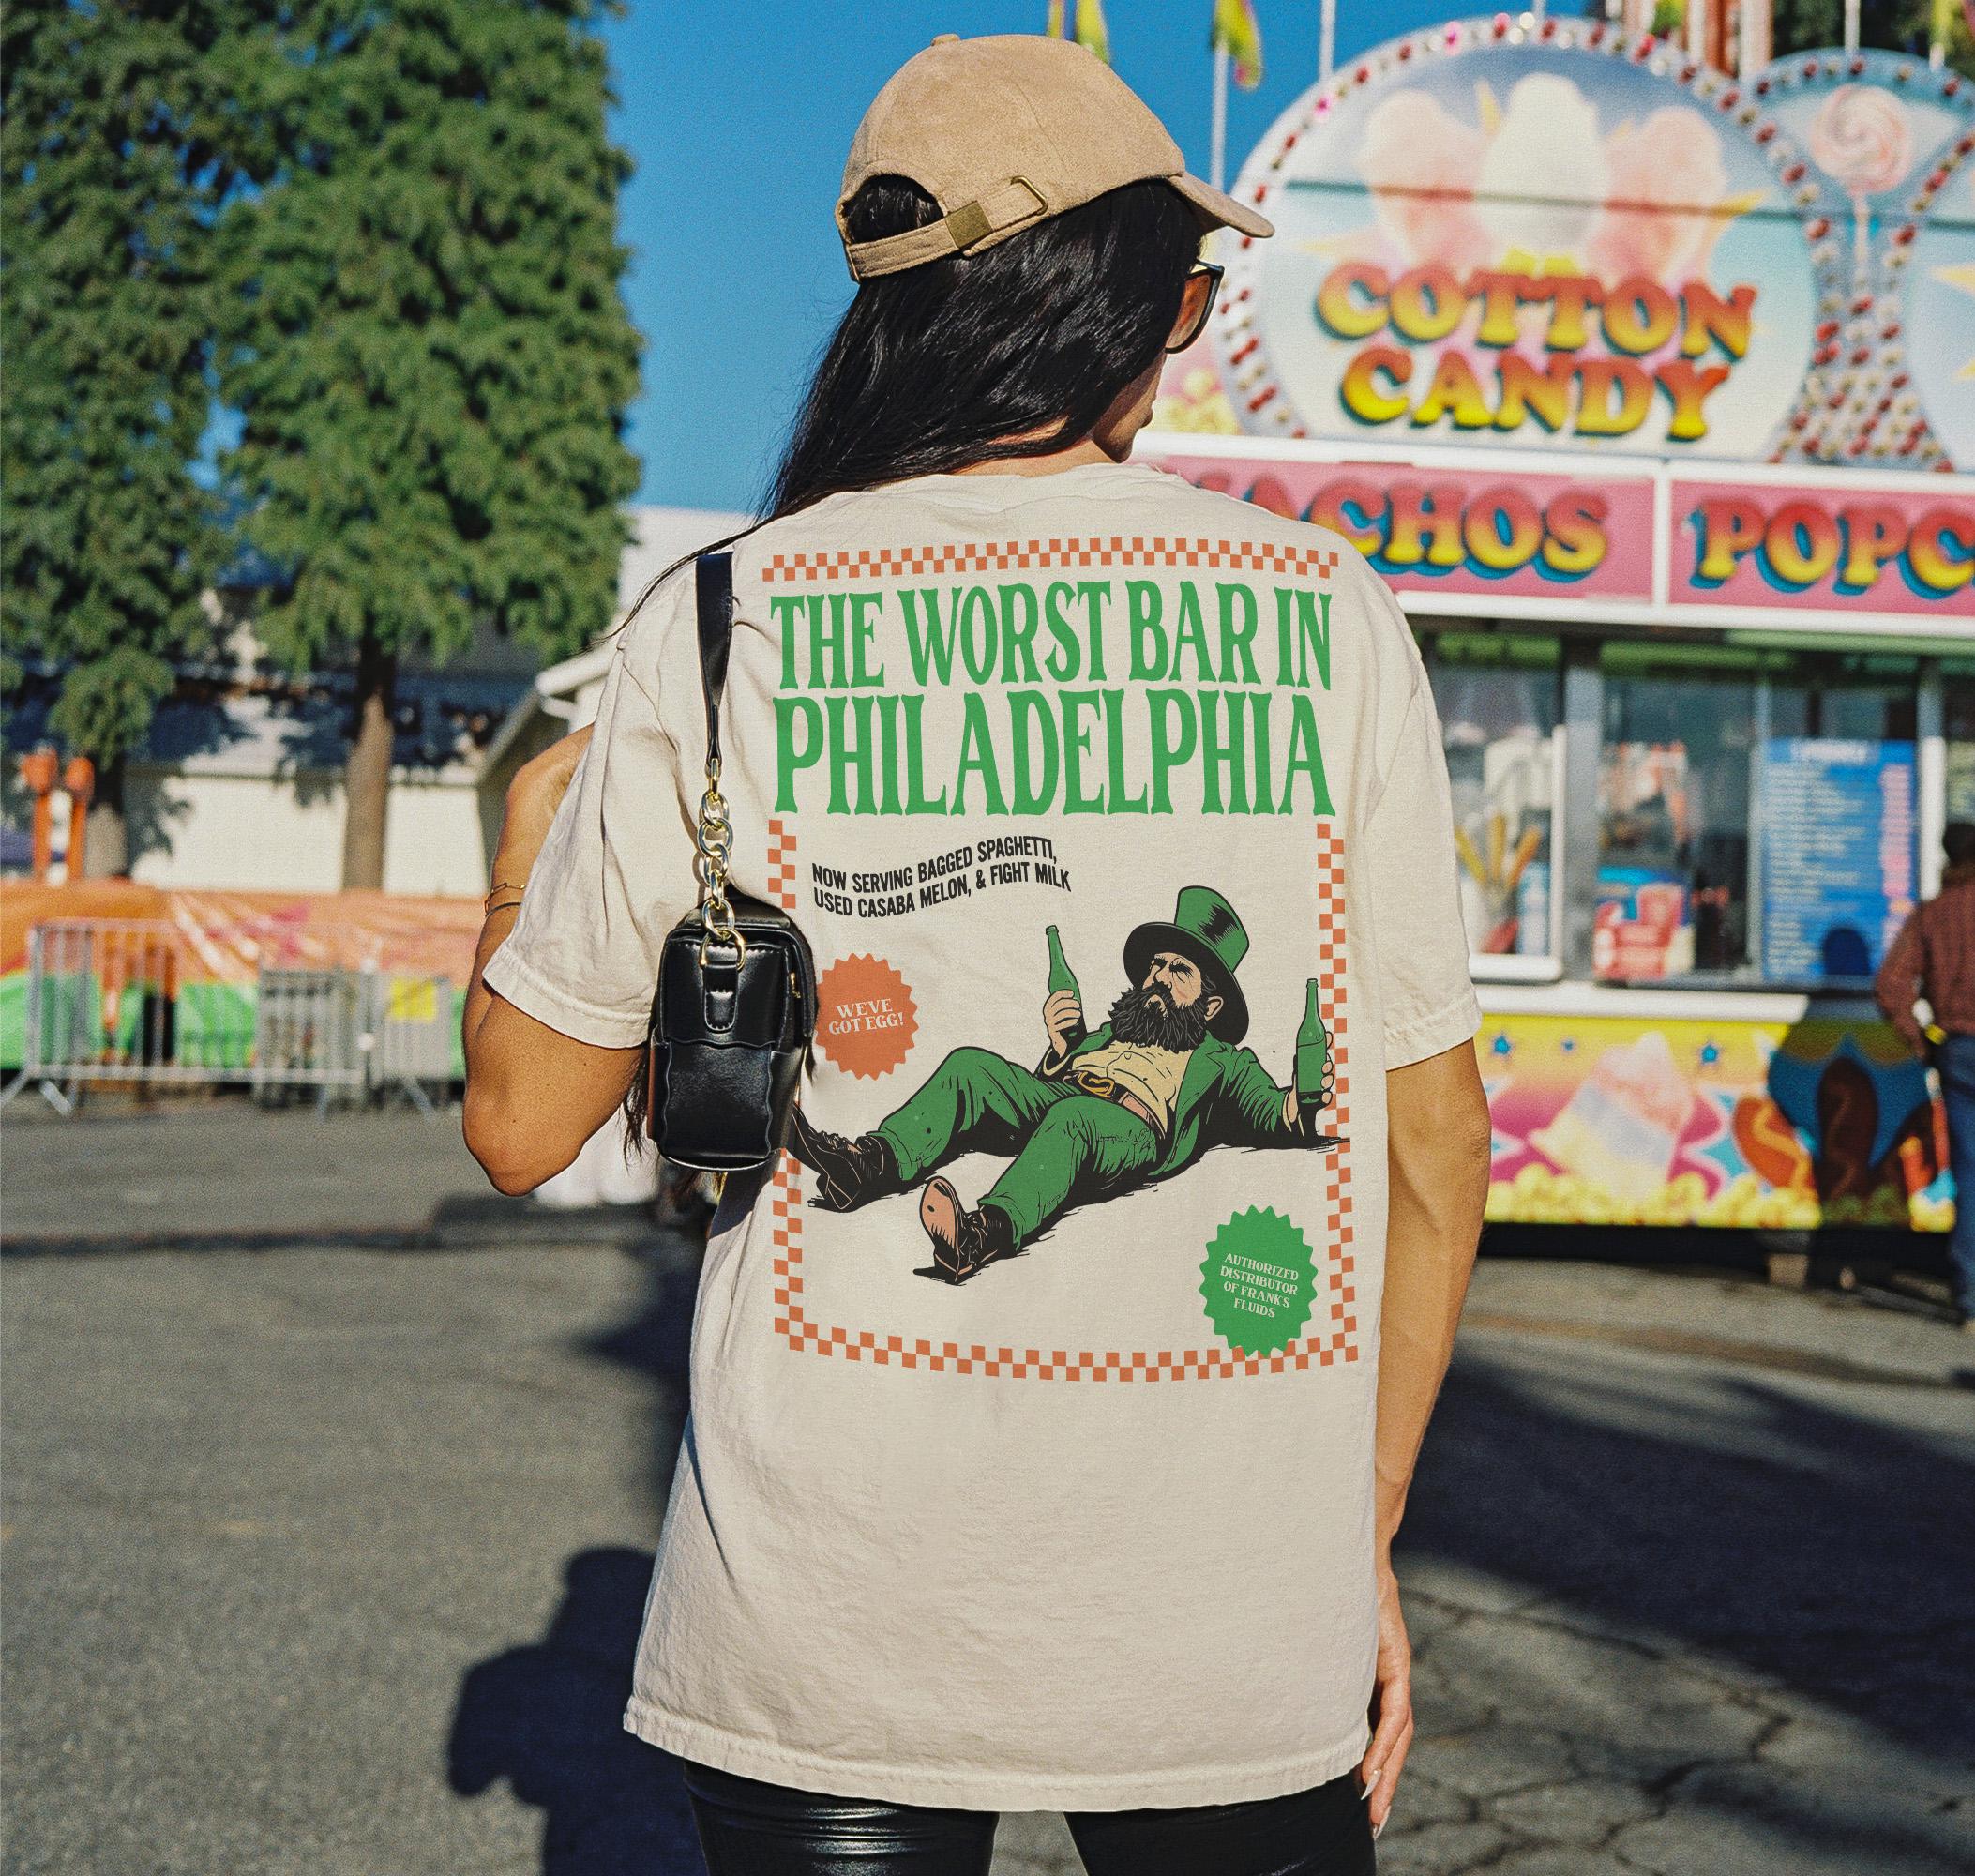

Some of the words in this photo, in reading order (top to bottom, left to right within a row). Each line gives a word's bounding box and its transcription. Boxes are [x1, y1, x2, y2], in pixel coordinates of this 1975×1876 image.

[1315, 261, 1758, 362] COTTON
[1338, 345, 1732, 442] CANDY
[1196, 469, 1610, 583] CHOS
[771, 591, 884, 689] THE
[897, 579, 1112, 687] WORST
[1125, 579, 1261, 685] BAR
[1274, 586, 1332, 690] IN
[773, 688, 1336, 816] PHILADELPHIA
[812, 863, 847, 891] NOW
[852, 867, 913, 893] SERVING
[918, 846, 973, 883] BAGGED
[977, 835, 1057, 864] SPAGHETTI,
[814, 887, 852, 916] USED
[858, 892, 915, 918] CASABA
[920, 873, 972, 909] MELON,
[975, 870, 987, 890] &
[990, 862, 1030, 886] FIGHT
[1035, 863, 1072, 892] MILK
[828, 1017, 861, 1036] GOT
[865, 1011, 904, 1031] EGG!
[1220, 1265, 1298, 1295] DISTRIBUTOR
[1223, 1280, 1240, 1294] OF
[1224, 1252, 1299, 1281] AUTHORIZED
[1233, 1297, 1275, 1318] FLUIDS
